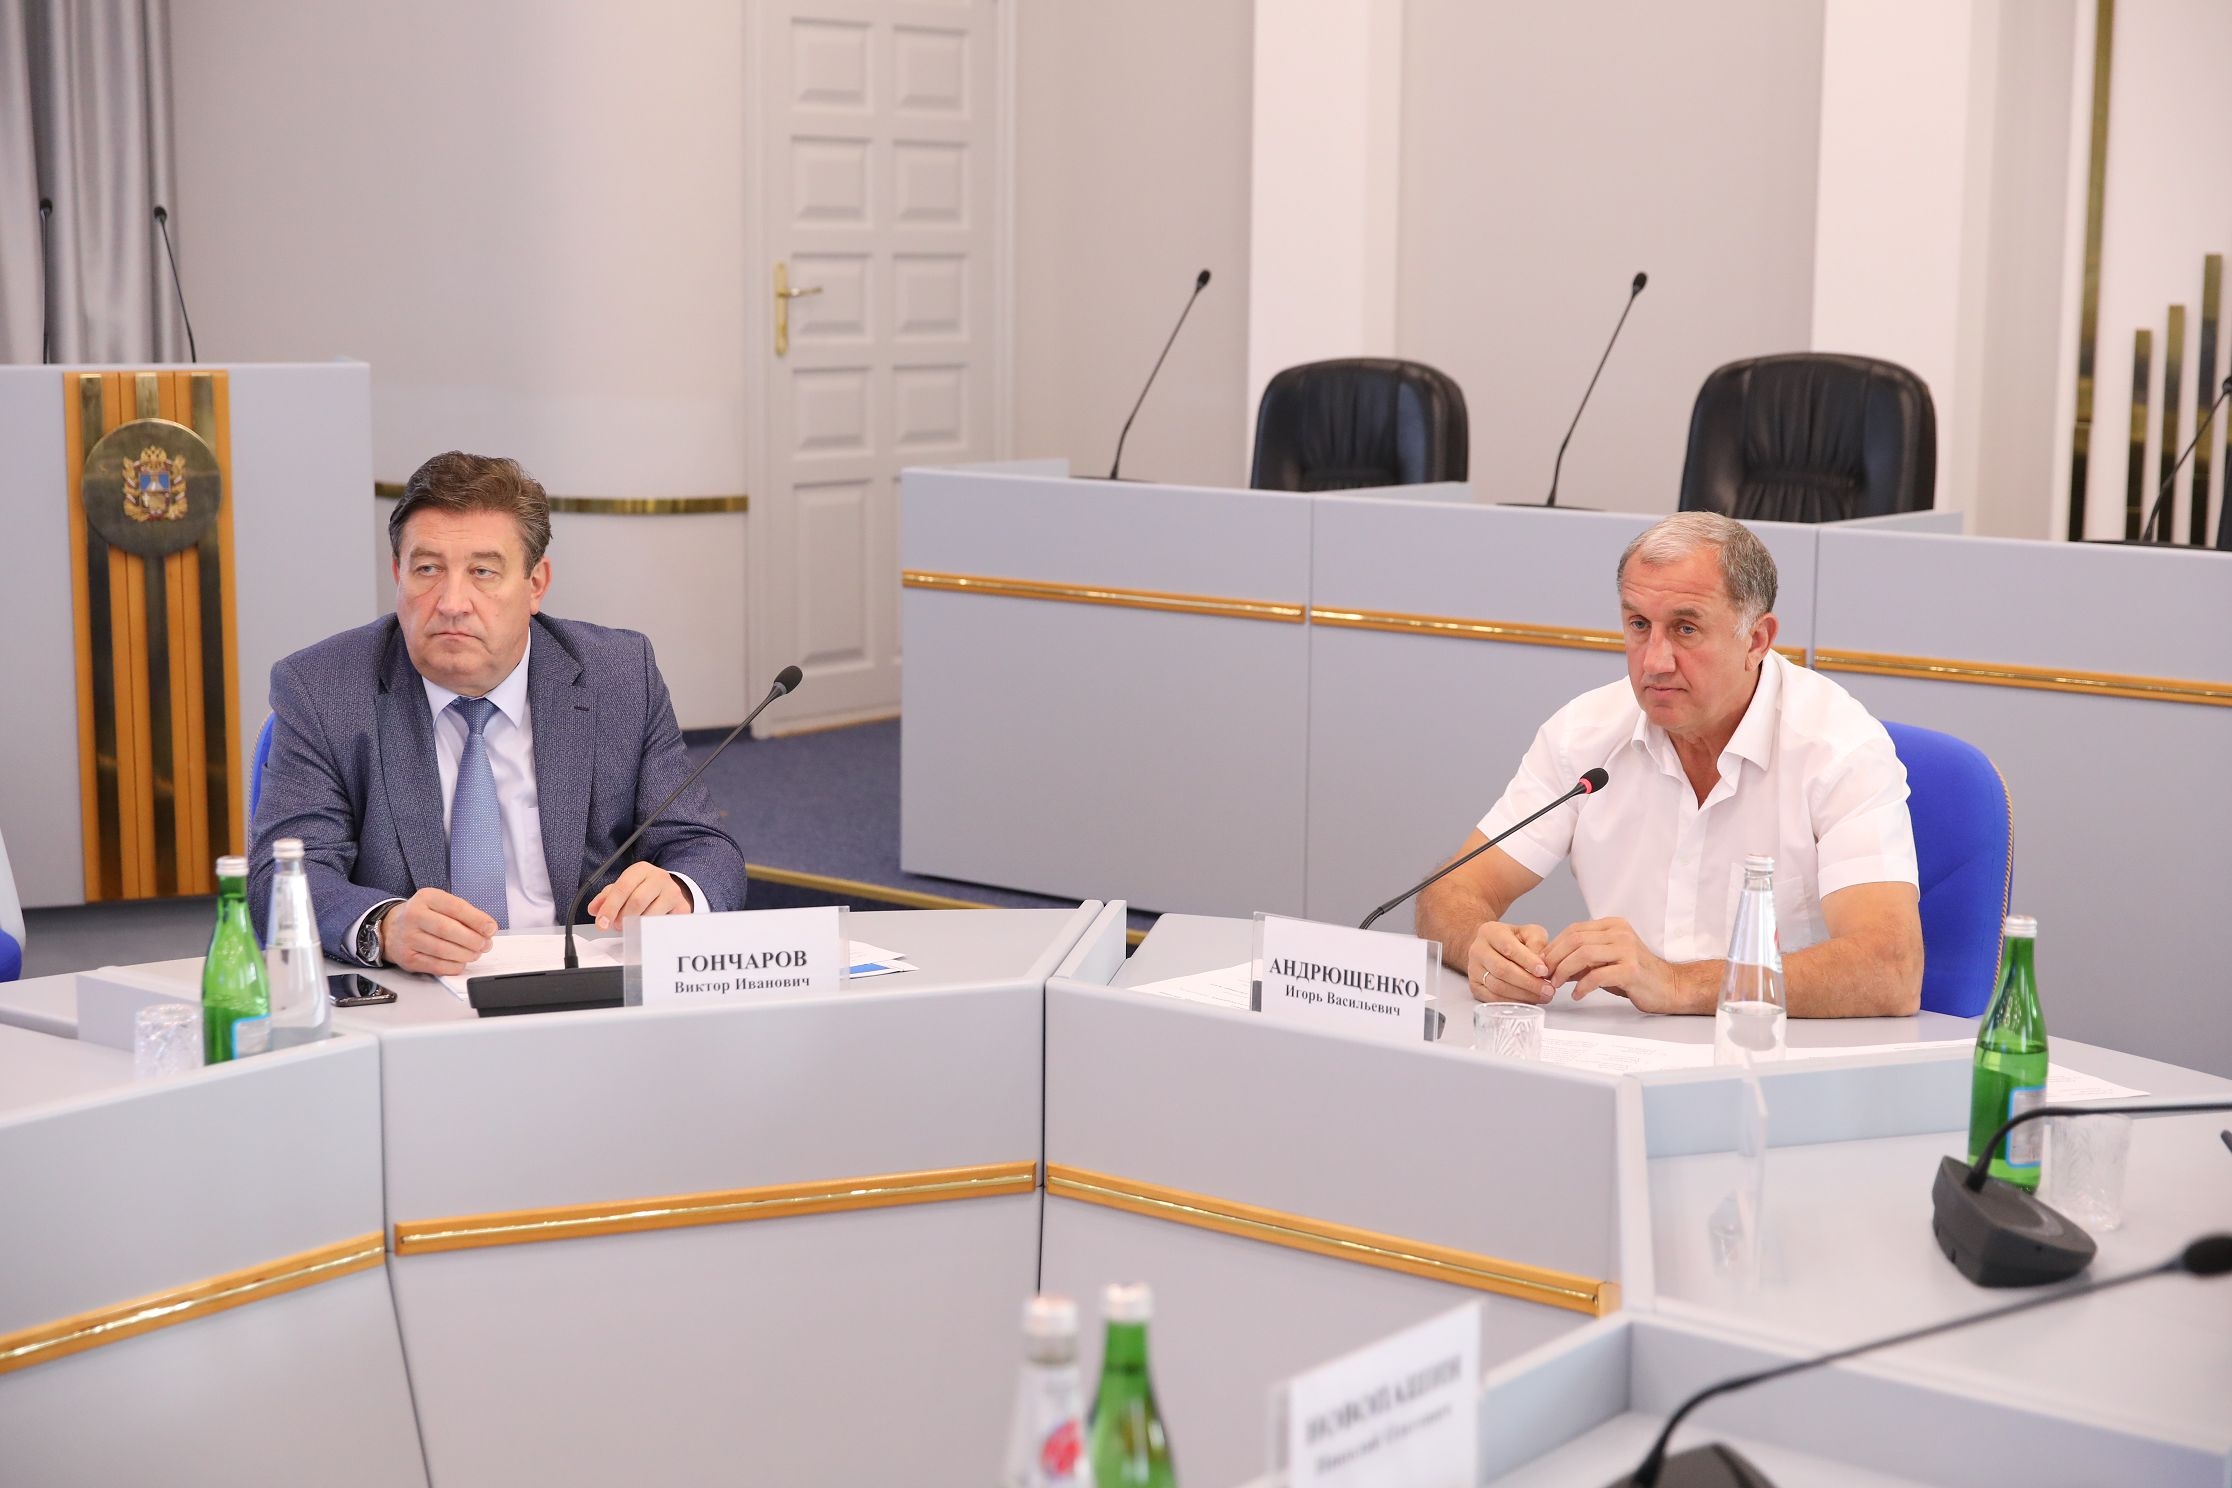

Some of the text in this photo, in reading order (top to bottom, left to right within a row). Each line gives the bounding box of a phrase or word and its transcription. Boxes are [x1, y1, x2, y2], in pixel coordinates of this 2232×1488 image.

[677, 950, 807, 973] ГОНЧАРОВ
[674, 978, 810, 994] Виктор Иванович
[1269, 957, 1420, 998] АНДРЮЩЕНКО
[1285, 984, 1401, 1017] Игорь Васильевич
